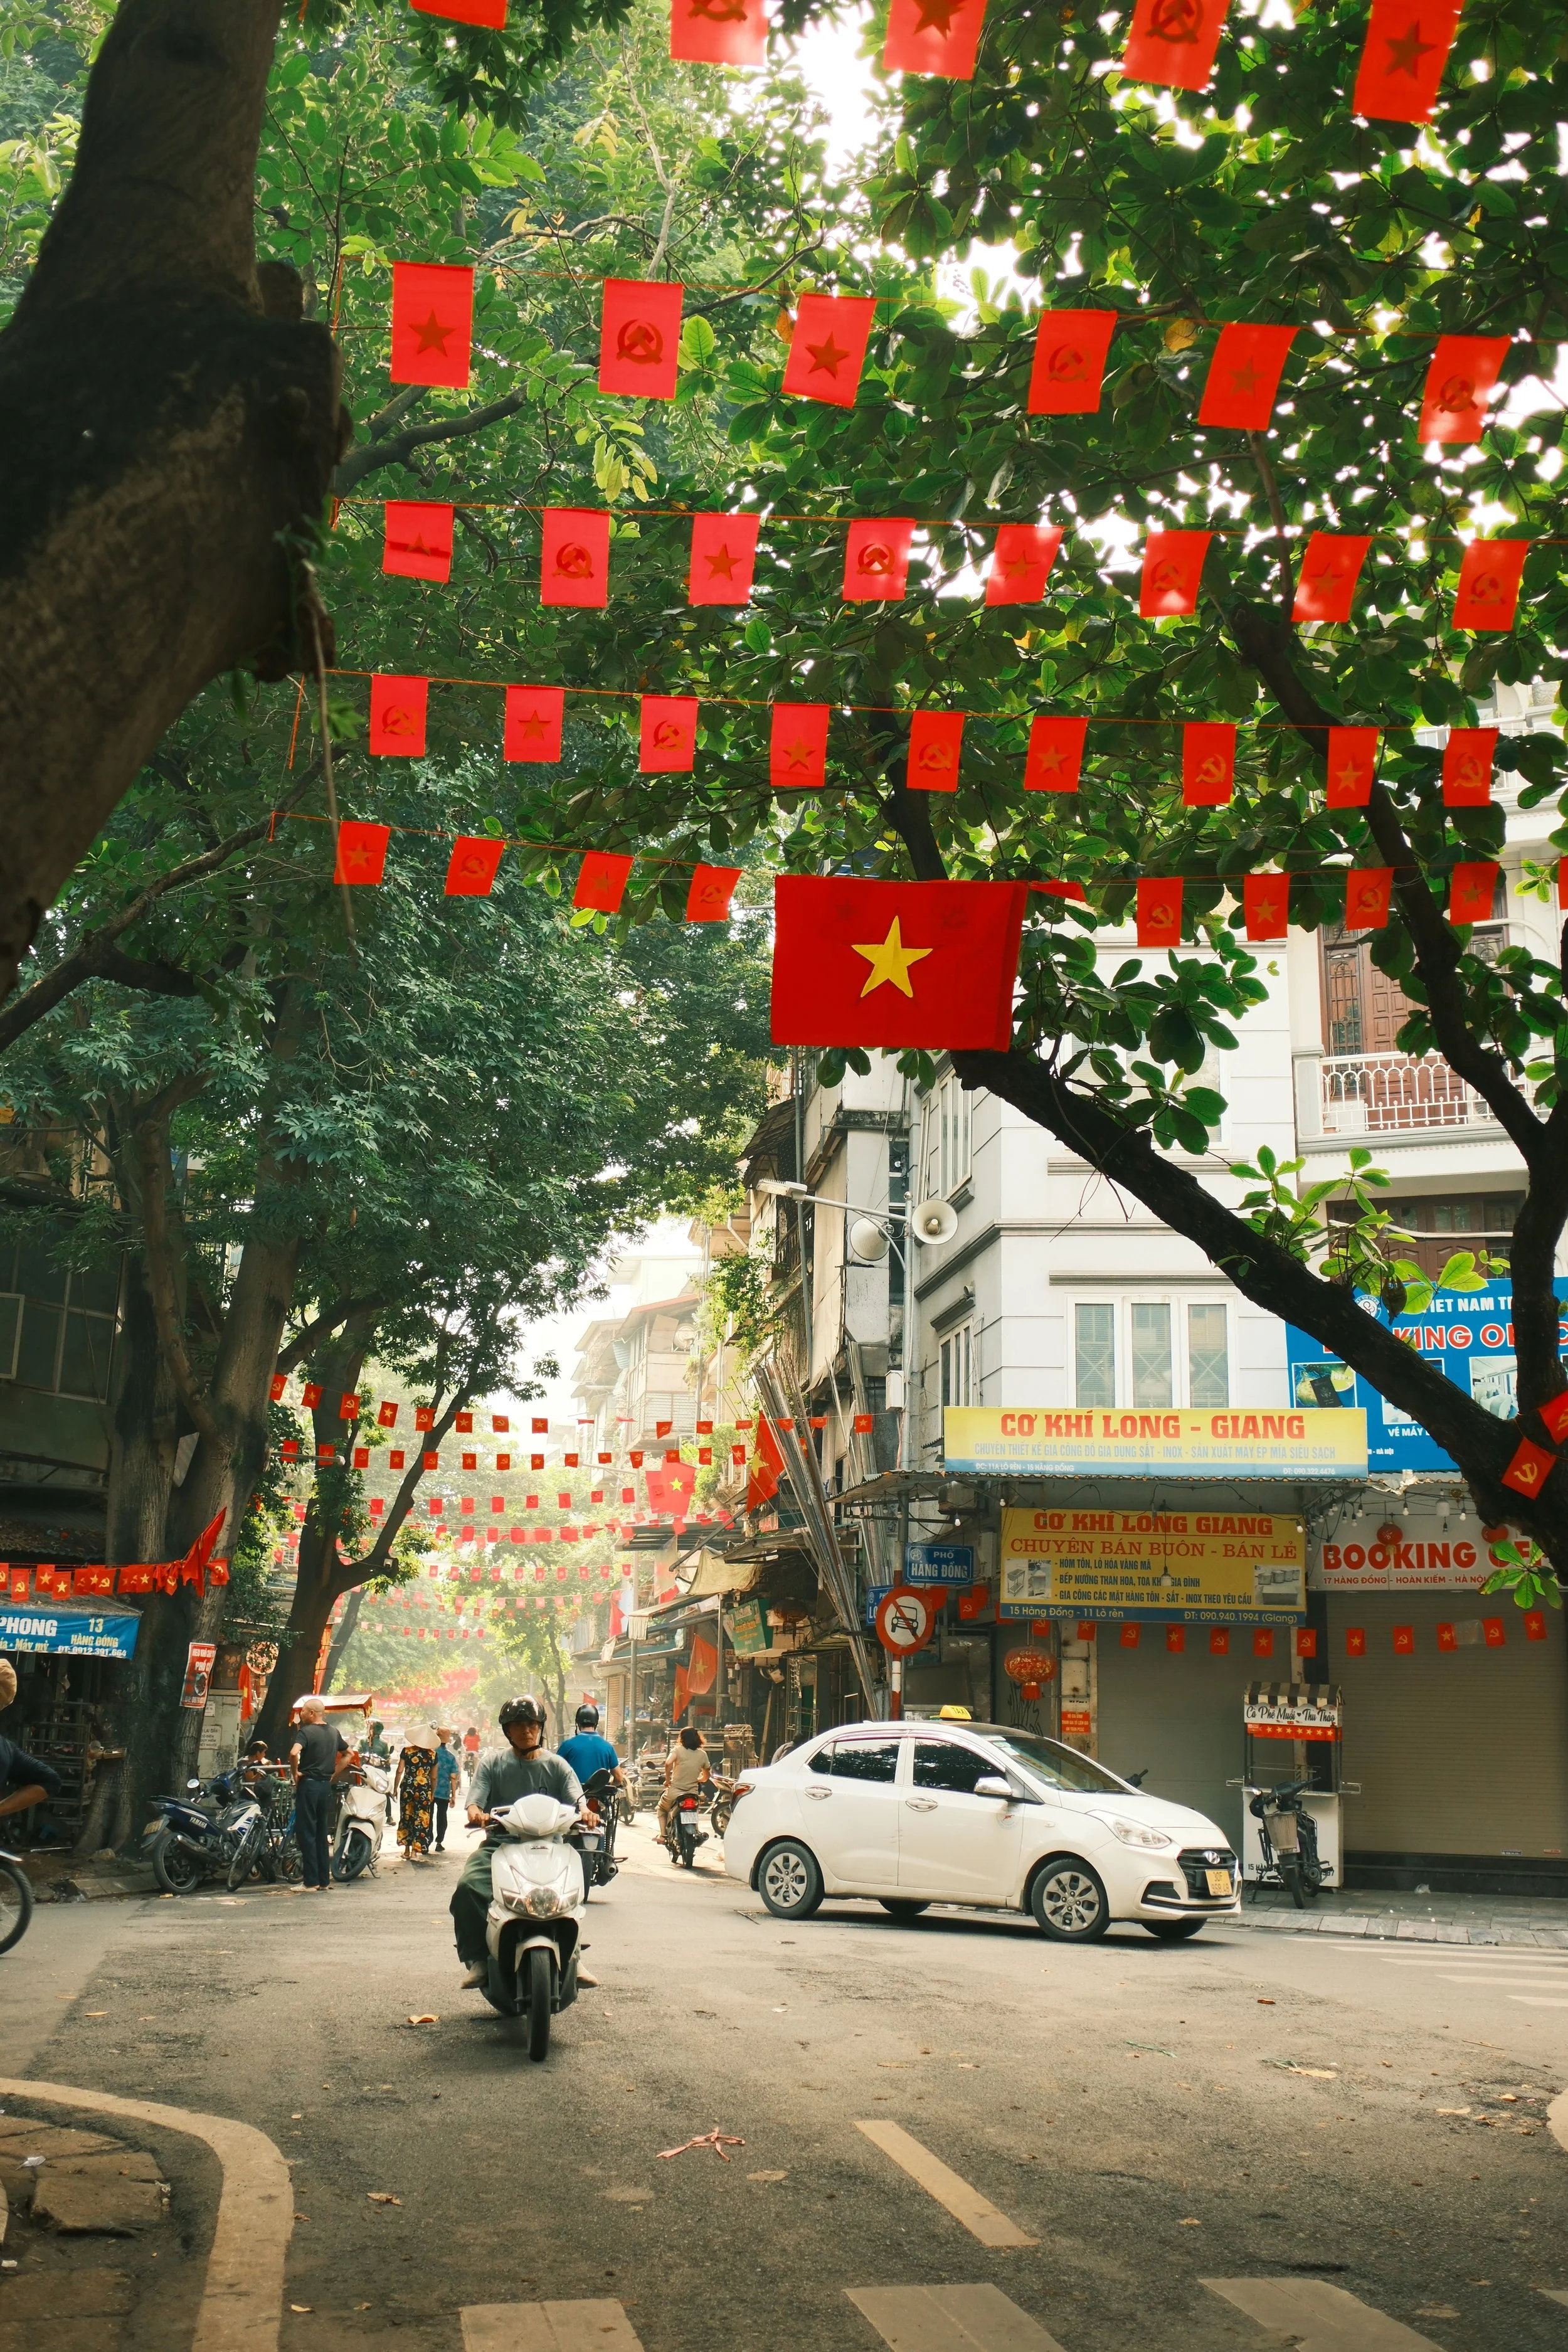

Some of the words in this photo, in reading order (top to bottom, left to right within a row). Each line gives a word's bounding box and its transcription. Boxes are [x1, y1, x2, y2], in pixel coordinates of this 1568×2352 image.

[1458, 1297, 1495, 1311] NAM
[1001, 1414, 1037, 1437] CƠ
[1044, 1409, 1093, 1438] KHÍ
[1103, 1415, 1180, 1438] LONG
[1211, 1415, 1305, 1439] GIANG
[1387, 1426, 1400, 1437] VÉ
[1402, 1426, 1424, 1436] MÁY
[975, 1441, 1005, 1454] CHUYÊN
[1008, 1440, 1029, 1456] THIẾT
[1032, 1441, 1042, 1456] KẾ
[1044, 1444, 1057, 1456] GIA
[1060, 1442, 1082, 1456] CÔNG
[1098, 1445, 1111, 1458] GIA
[1139, 1441, 1155, 1458] SẮT
[1163, 1446, 1182, 1458] INOX
[1191, 1442, 1209, 1458] SẢN
[1211, 1442, 1232, 1458] XUẤT
[1236, 1444, 1254, 1458] MÁY
[1256, 1444, 1267, 1459] ÉP
[1270, 1444, 1287, 1459] MÍA
[1290, 1444, 1309, 1459] SIÊU
[1312, 1446, 1335, 1461] SẠCH
[1010, 1462, 1021, 1470] RÈN
[1036, 1463, 1053, 1471] HÀNG
[1034, 1512, 1066, 1530] CƠ
[1072, 1510, 1115, 1532] KHÍ
[1121, 1515, 1188, 1533] LONG
[1195, 1517, 1273, 1535] GIANG
[933, 1549, 955, 1559] PHỐ
[1010, 1537, 1094, 1554] CHUYÊN
[1101, 1538, 1143, 1555] BÁN
[1148, 1540, 1205, 1557] BUÔN
[1222, 1540, 1265, 1558] BÁN
[1271, 1540, 1297, 1559] LẺ
[1059, 1556, 1075, 1568] HÒM
[1077, 1558, 1092, 1570] TÔN,
[1104, 1558, 1118, 1569] HÓA
[1120, 1558, 1138, 1570] VÀNG
[1323, 1541, 1477, 1571] BOOKING
[911, 1560, 938, 1577] HÀNG
[941, 1562, 967, 1578] ĐỒNG
[1059, 1572, 1073, 1584] BẾP
[1100, 1575, 1118, 1586] THAN
[1120, 1576, 1136, 1586] HOA,
[1138, 1576, 1150, 1586] TOA
[1184, 1576, 1200, 1587] ĐÌNH
[1334, 1576, 1359, 1584] HÀNG
[1361, 1574, 1387, 1584] ĐỒNG
[1396, 1575, 1421, 1583] HOÀN
[1424, 1573, 1446, 1583] KIẾM
[1455, 1574, 1468, 1583] HÀ
[1059, 1590, 1071, 1600] GIA
[1073, 1589, 1091, 1601] CÔNG
[1094, 1589, 1107, 1601] CÁC
[1109, 1591, 1123, 1603] MẶT
[1126, 1591, 1144, 1602] HÀNG
[1146, 1591, 1160, 1602] TÔN
[1167, 1590, 1179, 1602] SẮT
[1186, 1594, 1202, 1603] INOX
[1204, 1594, 1221, 1604] THEO
[1223, 1592, 1236, 1604] YÊU
[1010, 1606, 1020, 1614] 15
[1022, 1606, 1047, 1617] Hàng
[1049, 1606, 1074, 1618] Đồng
[1096, 1608, 1106, 1617] Lò
[1109, 1609, 1123, 1618] rèn
[1184, 1611, 1198, 1620] ĐT:
[1200, 1611, 1259, 1621] 090.940.1994
[1262, 1613, 1297, 1624] (Giang)
[89, 1618, 103, 1633] 13
[71, 1633, 94, 1646] HÀNG
[72, 1646, 127, 1656] 0912.391.664
[951, 1707, 968, 1715] TAXI
[1246, 1706, 1256, 1719] Cà
[1258, 1706, 1275, 1719] Phê
[1277, 1708, 1296, 1720] Muối
[1316, 1709, 1335, 1722] Thảo
[189, 1816, 208, 1830] YAMAHA
